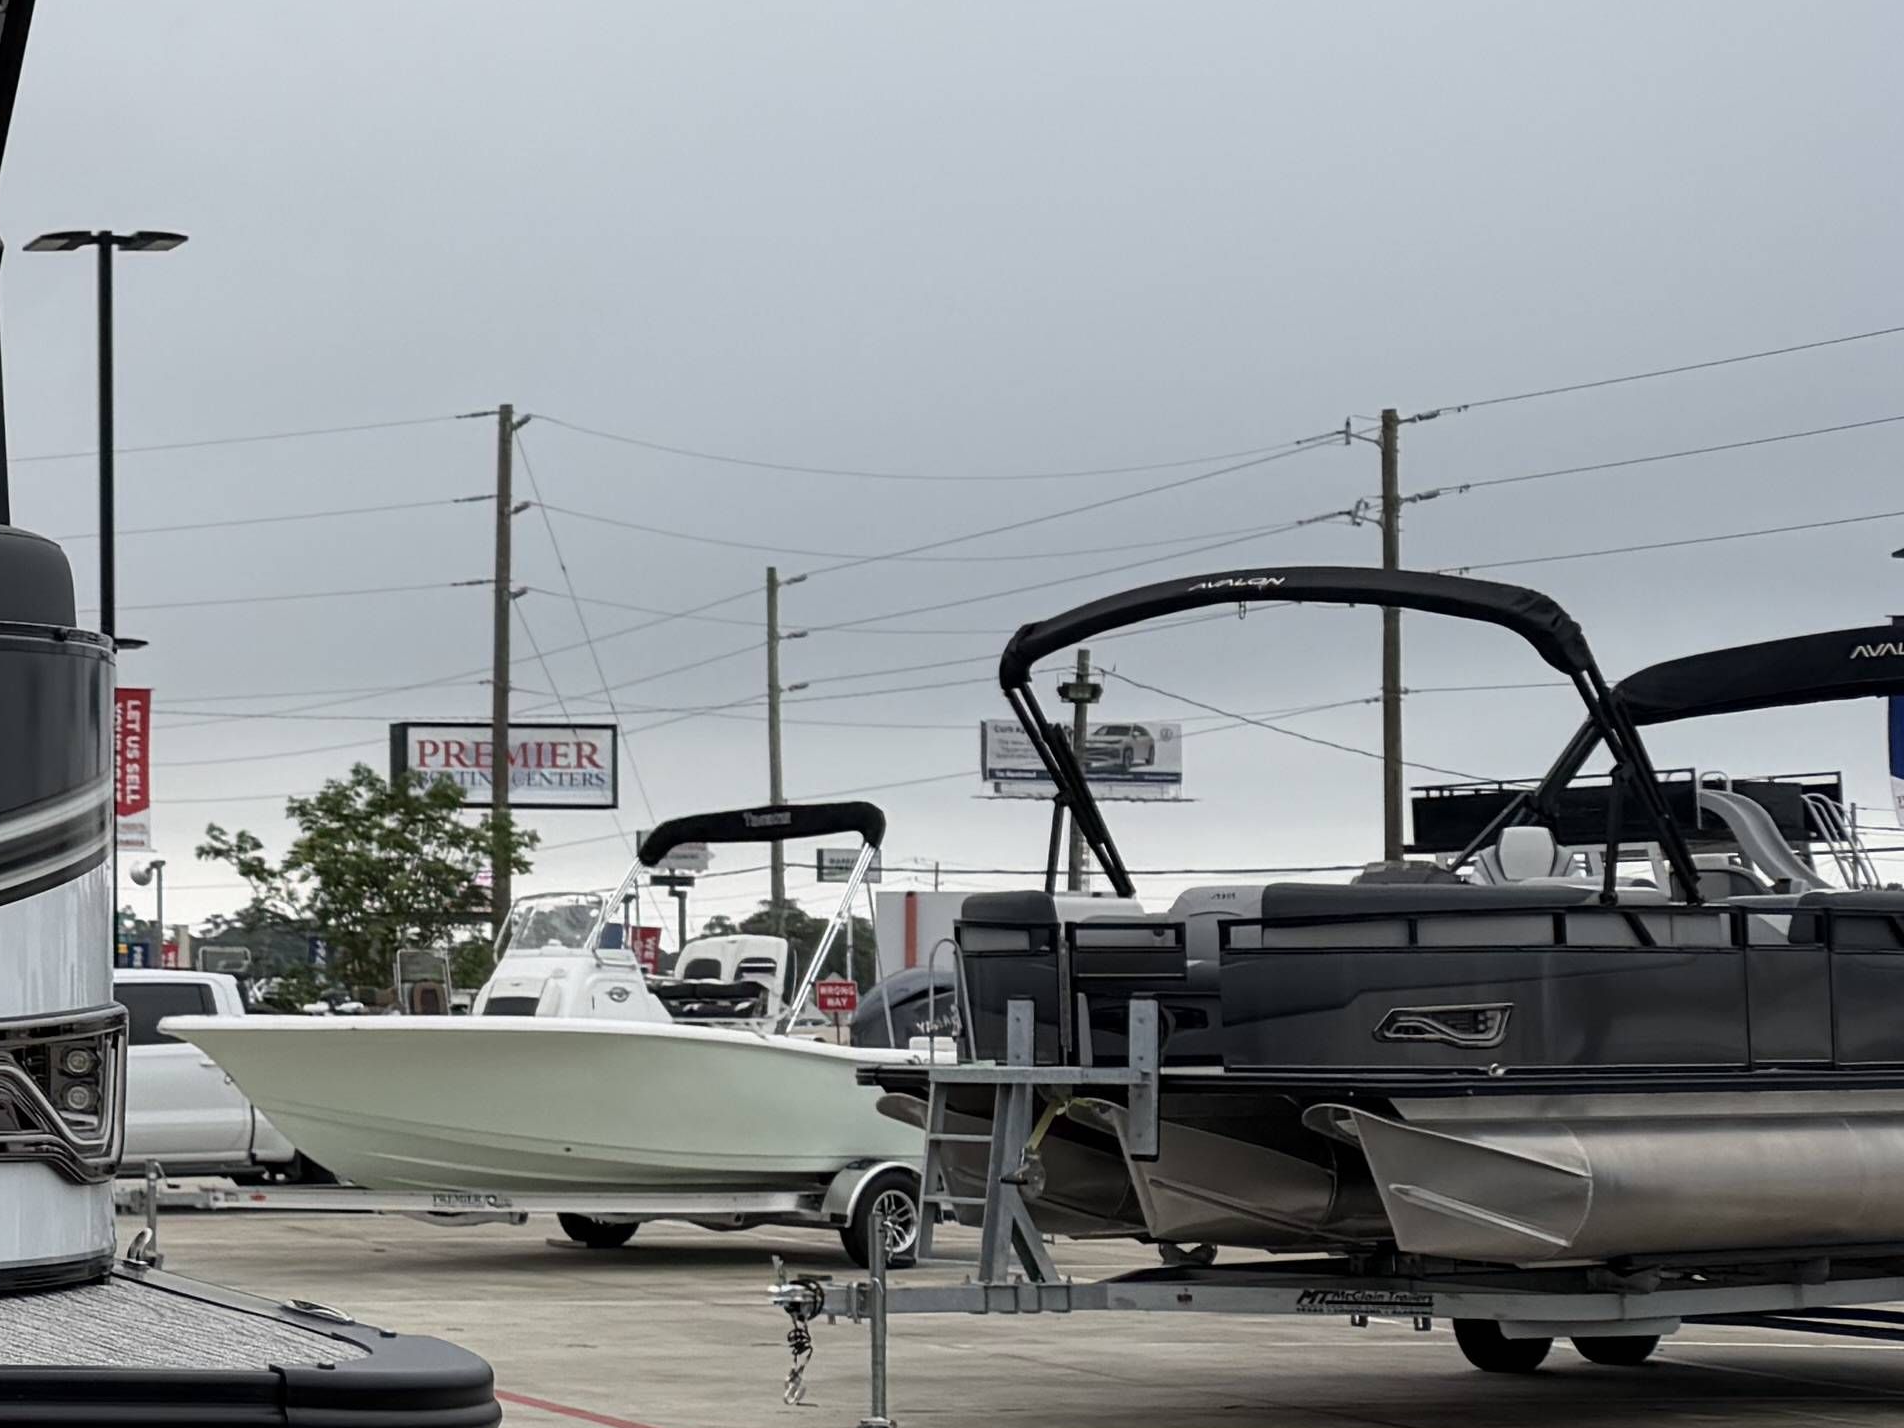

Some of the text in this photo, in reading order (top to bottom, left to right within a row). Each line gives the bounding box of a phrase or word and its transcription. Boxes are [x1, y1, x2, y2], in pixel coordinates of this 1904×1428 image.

[126, 699, 142, 732] LET
[126, 735, 141, 759] US
[417, 740, 604, 769] PREMIER
[125, 763, 141, 804] SELL
[512, 771, 606, 788] CENTERS
[820, 985, 854, 996] WRONG
